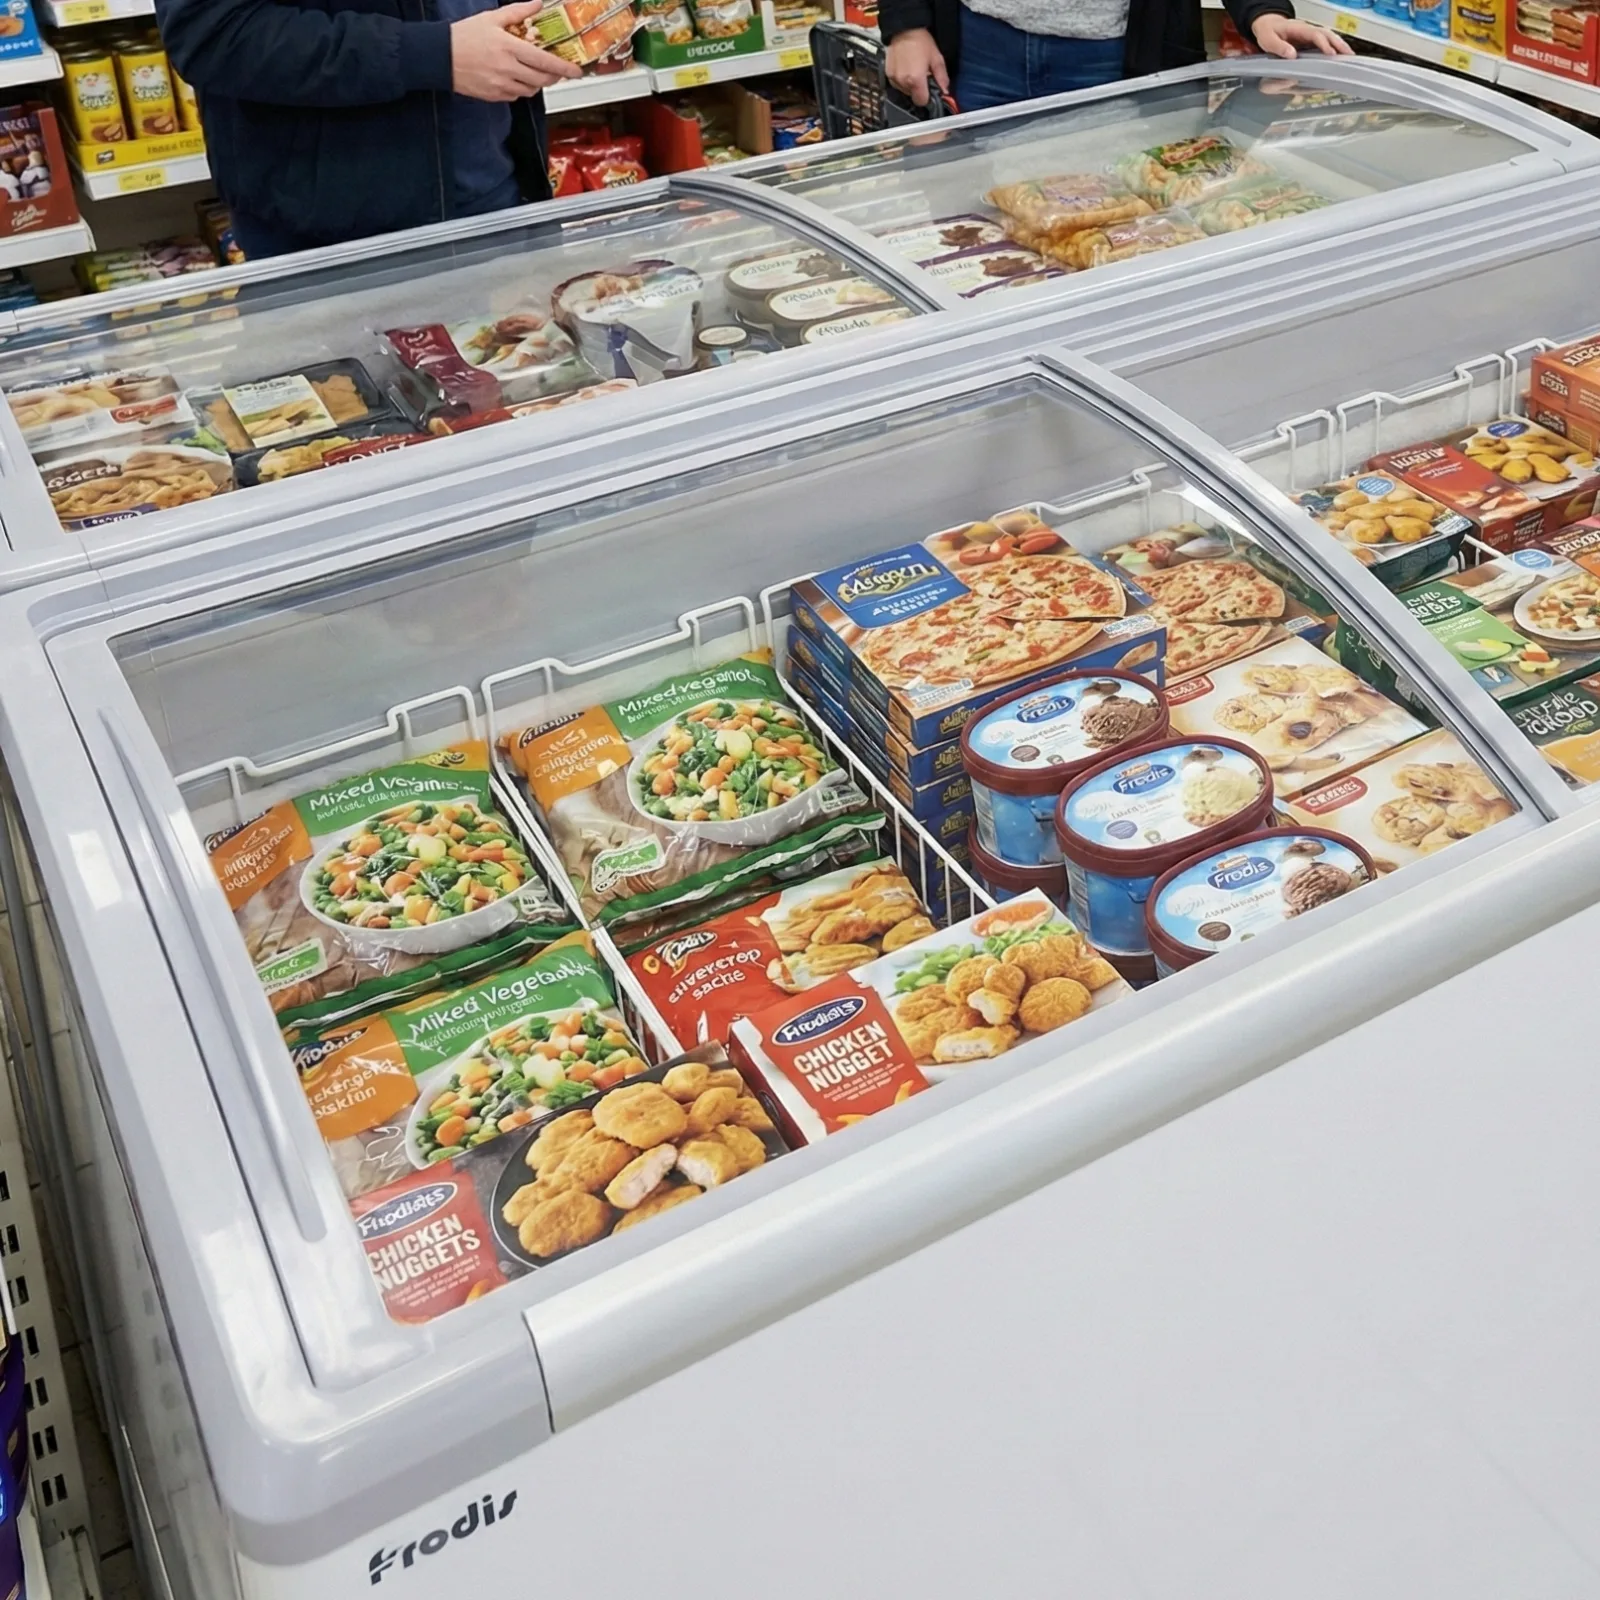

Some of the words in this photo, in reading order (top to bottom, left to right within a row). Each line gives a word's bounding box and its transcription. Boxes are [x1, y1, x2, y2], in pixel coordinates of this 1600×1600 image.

[618, 683, 677, 716] Mixed
[309, 777, 375, 812] Mixed
[1213, 860, 1270, 889] Frodis
[792, 1019, 888, 1074] CHICKEN
[805, 1038, 894, 1093] NUGGET
[366, 1212, 463, 1273] CHICKEN
[375, 1228, 481, 1294] NUGGETS
[368, 1489, 518, 1587] Frodis
